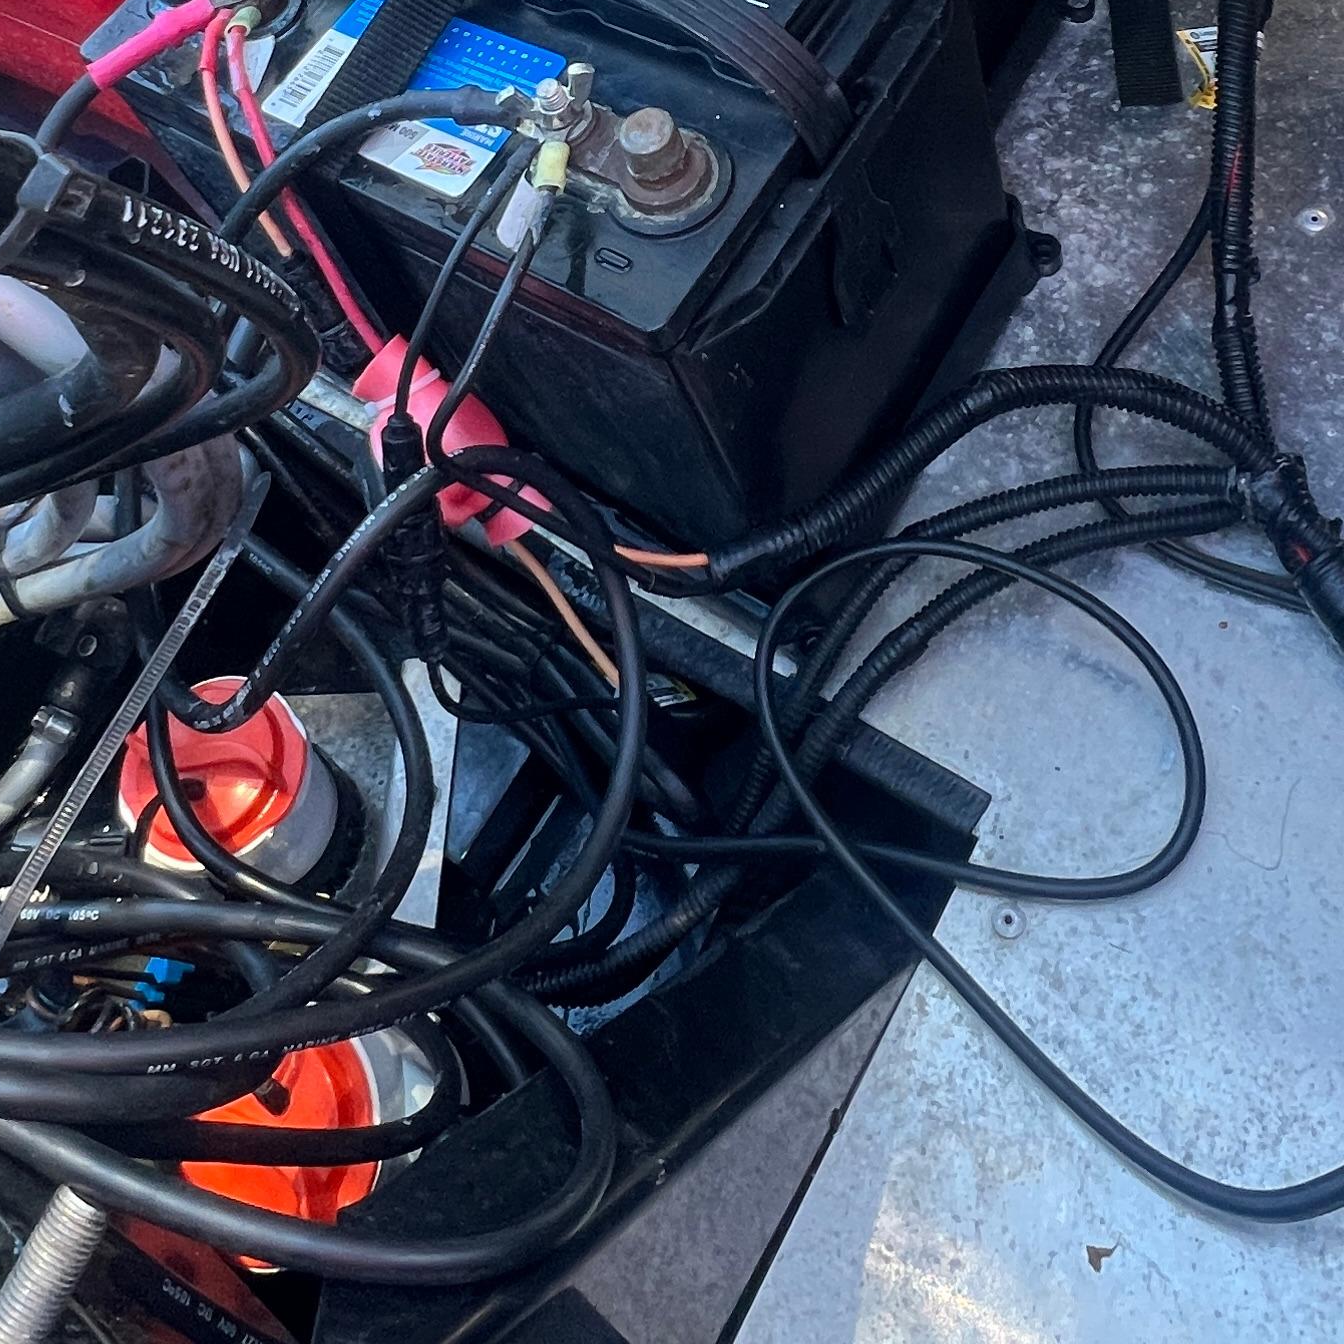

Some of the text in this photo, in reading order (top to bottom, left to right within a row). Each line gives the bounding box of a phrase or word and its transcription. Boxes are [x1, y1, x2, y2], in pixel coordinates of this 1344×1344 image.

[397, 125, 418, 140] 500
[334, 514, 376, 561] MARINE
[306, 568, 332, 602] WIRE
[19, 906, 41, 921] 60V
[45, 908, 61, 920] DC
[147, 1063, 176, 1074] MM
[283, 1034, 340, 1055] MARINE
